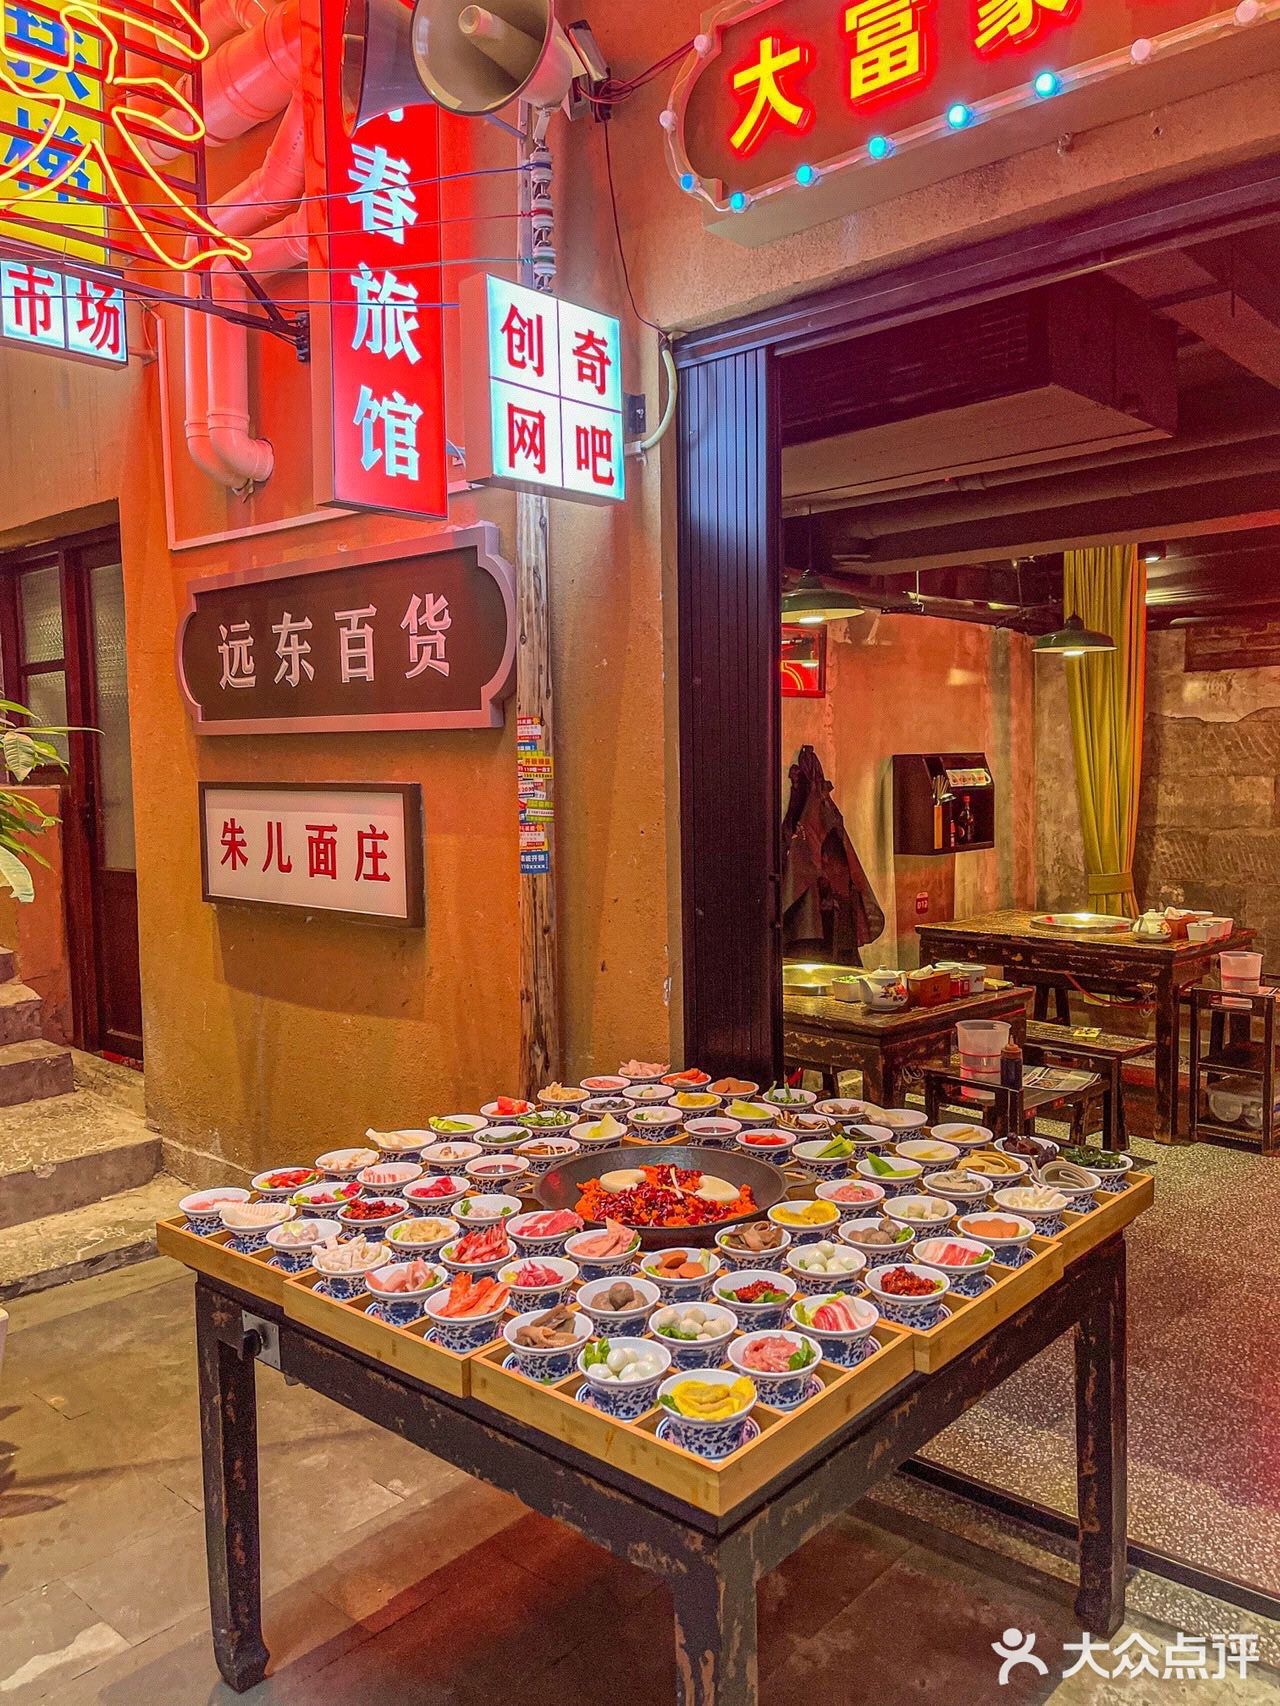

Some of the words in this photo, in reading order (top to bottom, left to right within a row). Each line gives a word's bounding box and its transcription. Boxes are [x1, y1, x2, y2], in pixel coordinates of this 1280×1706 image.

[8, 265, 121, 355] 市场
[347, 107, 422, 482] 春旅馆
[217, 592, 453, 690] 远东百货
[220, 817, 391, 883] 朱儿面庄
